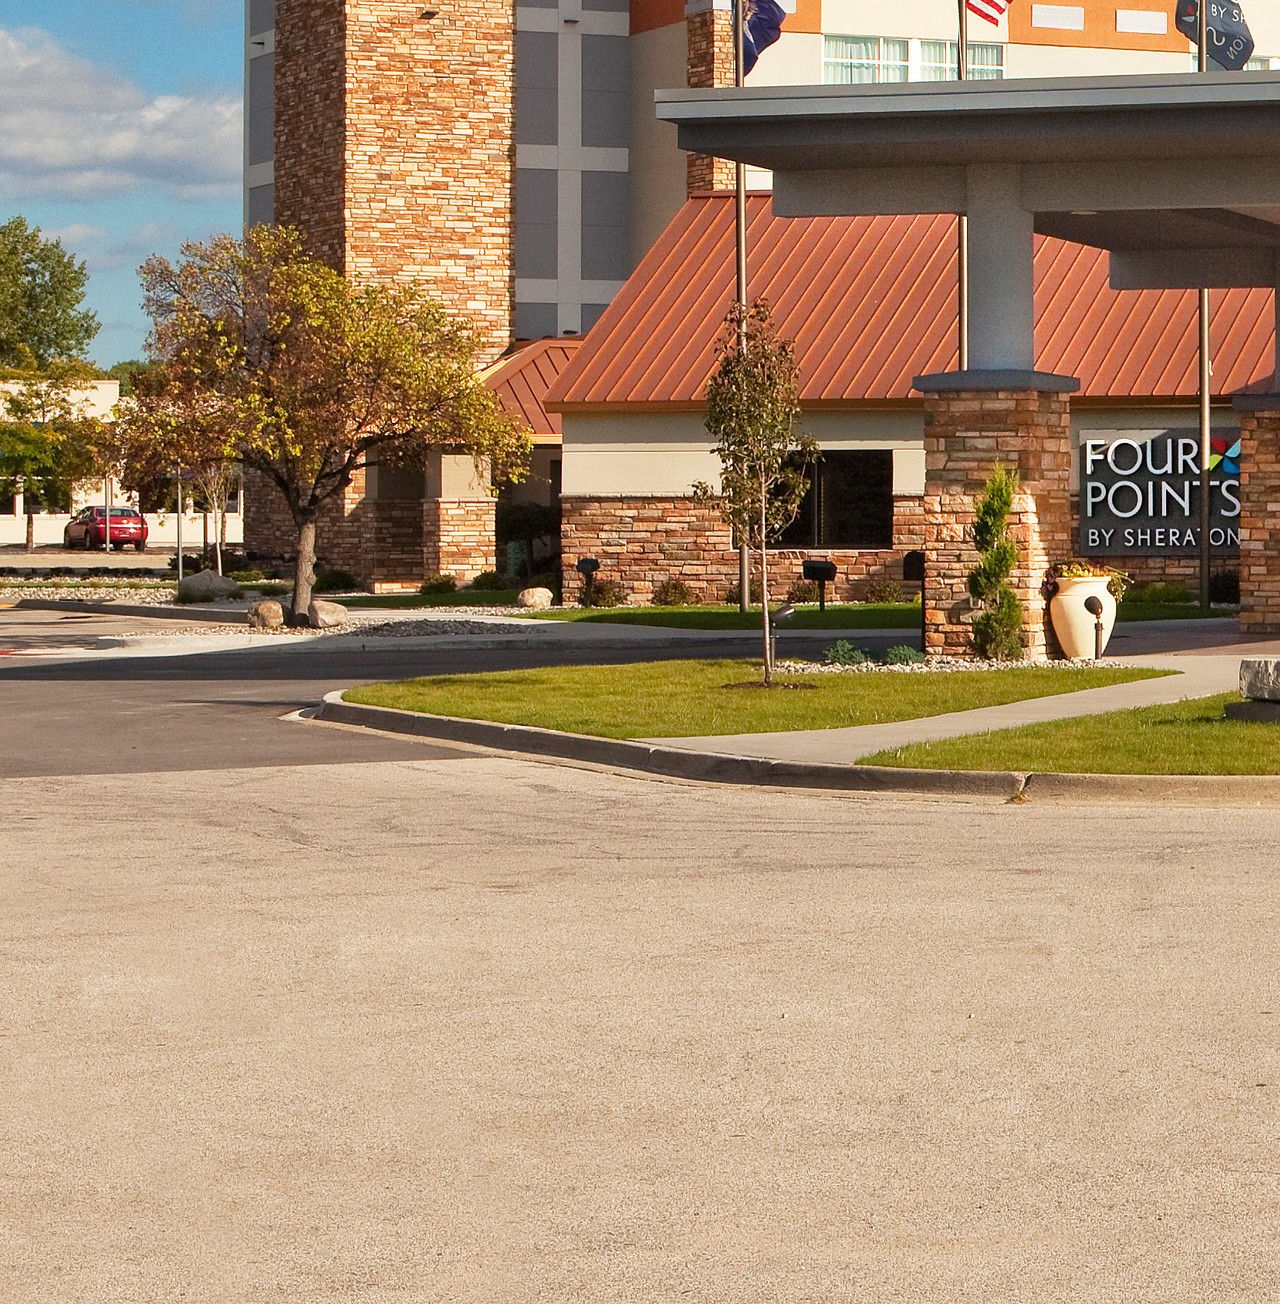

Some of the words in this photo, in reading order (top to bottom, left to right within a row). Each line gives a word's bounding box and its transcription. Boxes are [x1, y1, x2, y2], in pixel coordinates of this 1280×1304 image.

[1211, 4, 1227, 18] BY
[1086, 438, 1201, 475] FOUR
[1088, 528, 1115, 547] BY
[1124, 528, 1241, 547] SHERAON
